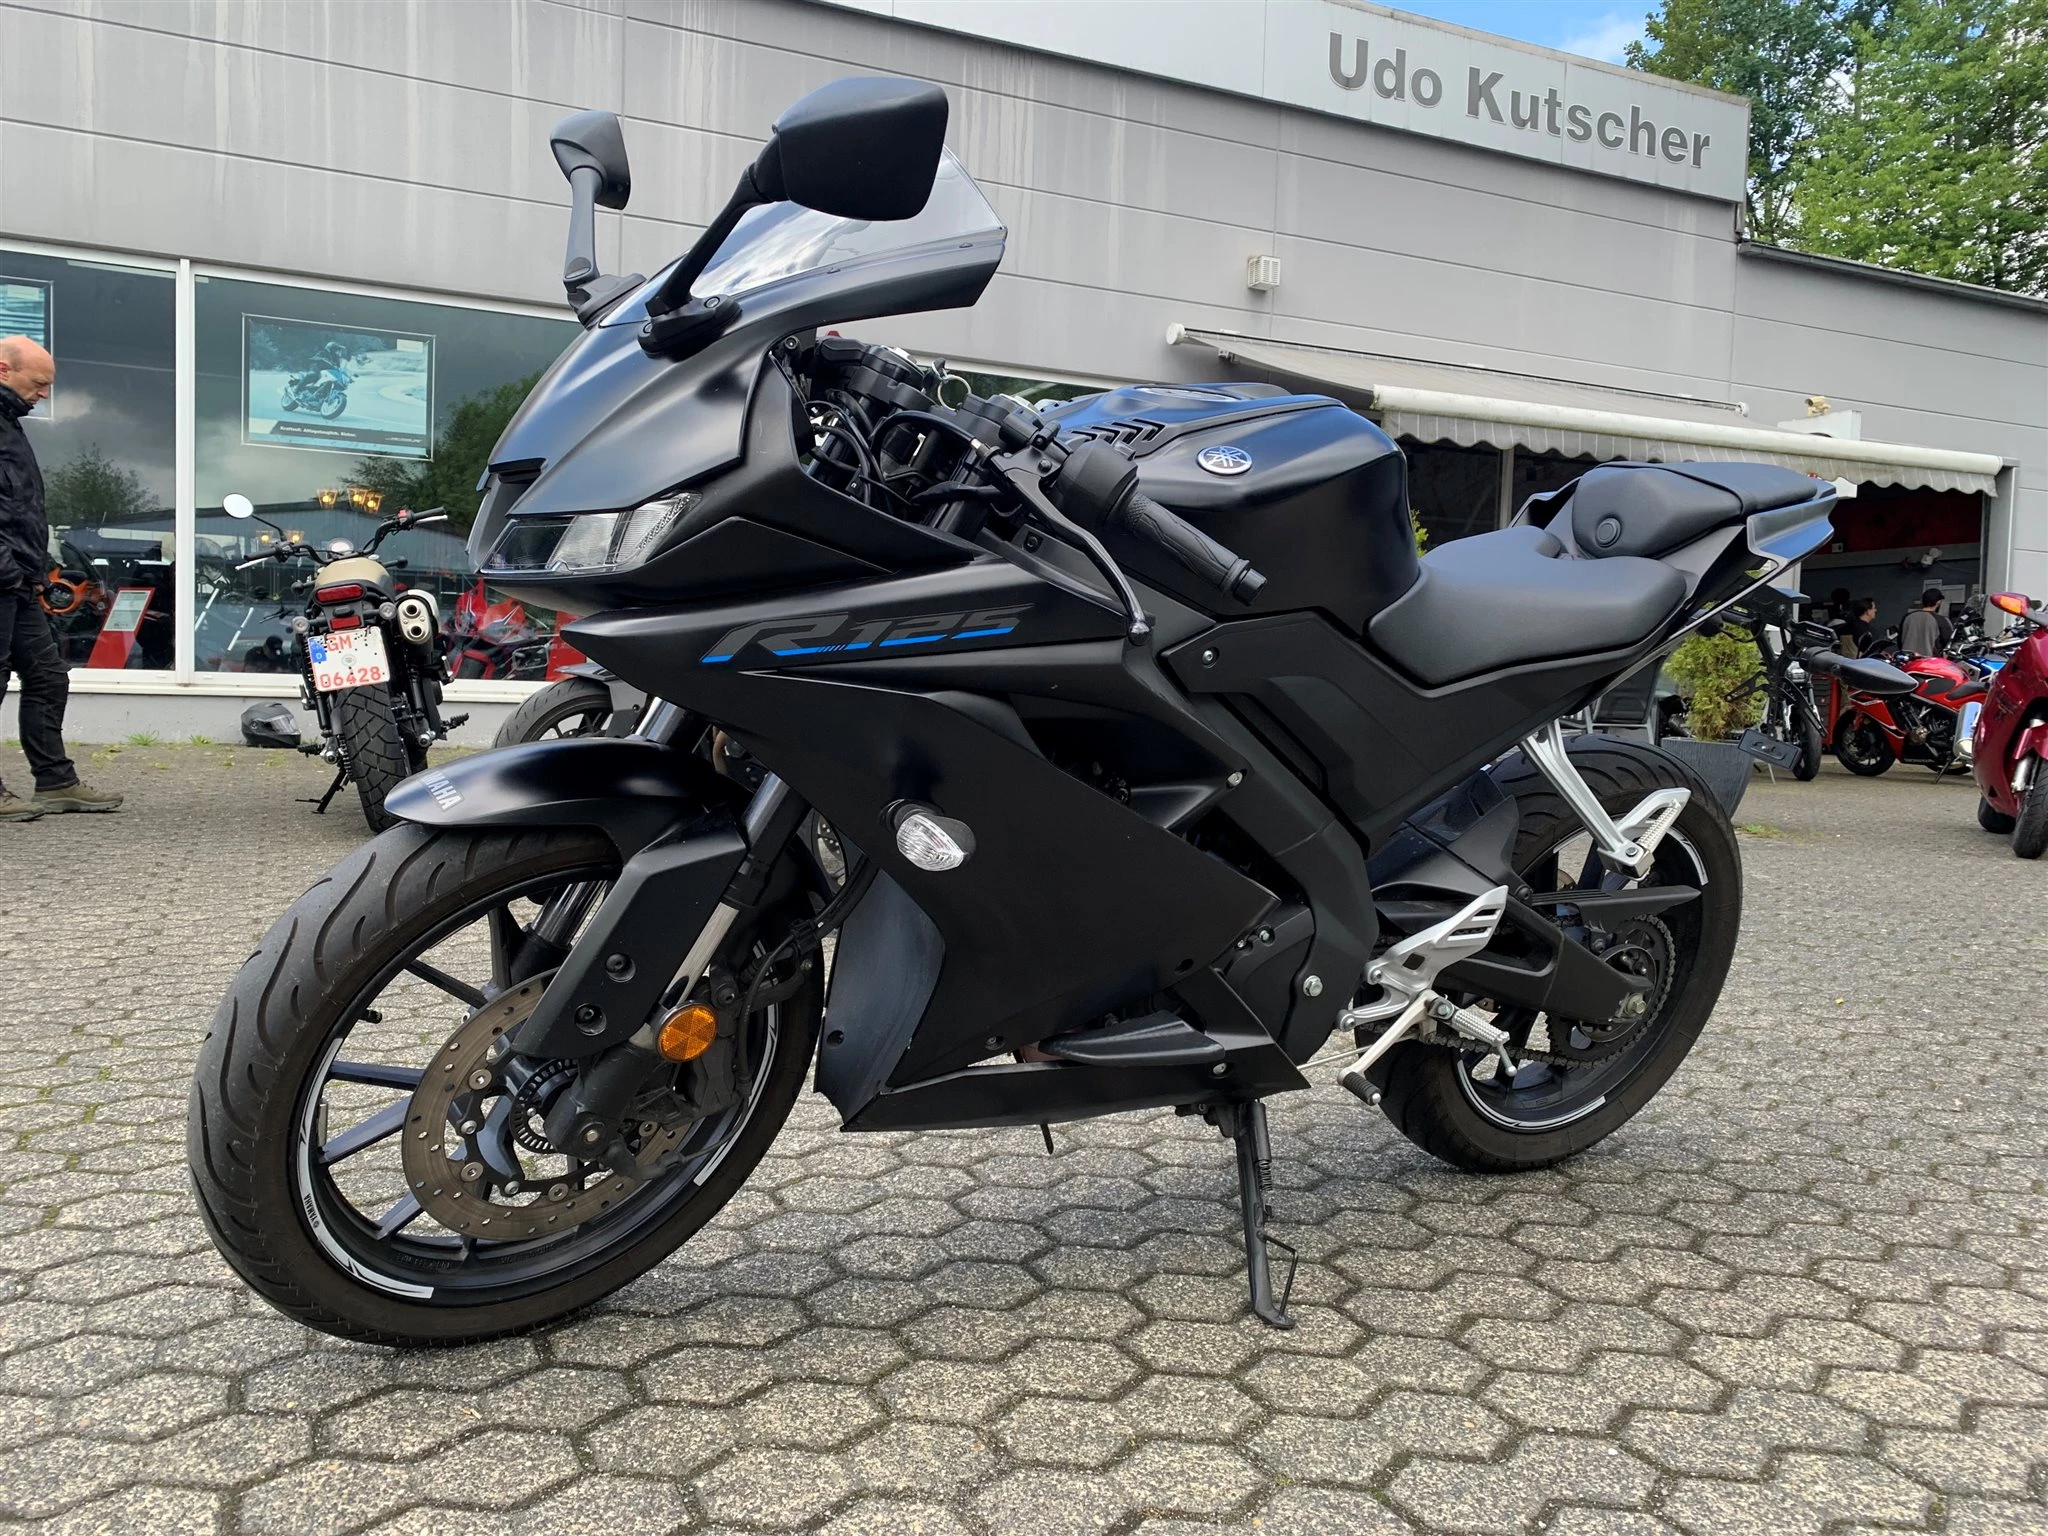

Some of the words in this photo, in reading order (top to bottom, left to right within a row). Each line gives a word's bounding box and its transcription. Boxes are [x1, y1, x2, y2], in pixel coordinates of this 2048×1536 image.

[1328, 31, 1443, 107] Udo
[1466, 65, 1711, 168] Kutscher
[315, 652, 323, 660] D
[326, 634, 353, 652] GM
[319, 666, 382, 689] 06428
[422, 770, 462, 810] MAHA
[303, 1192, 318, 1223] YAMAHA
